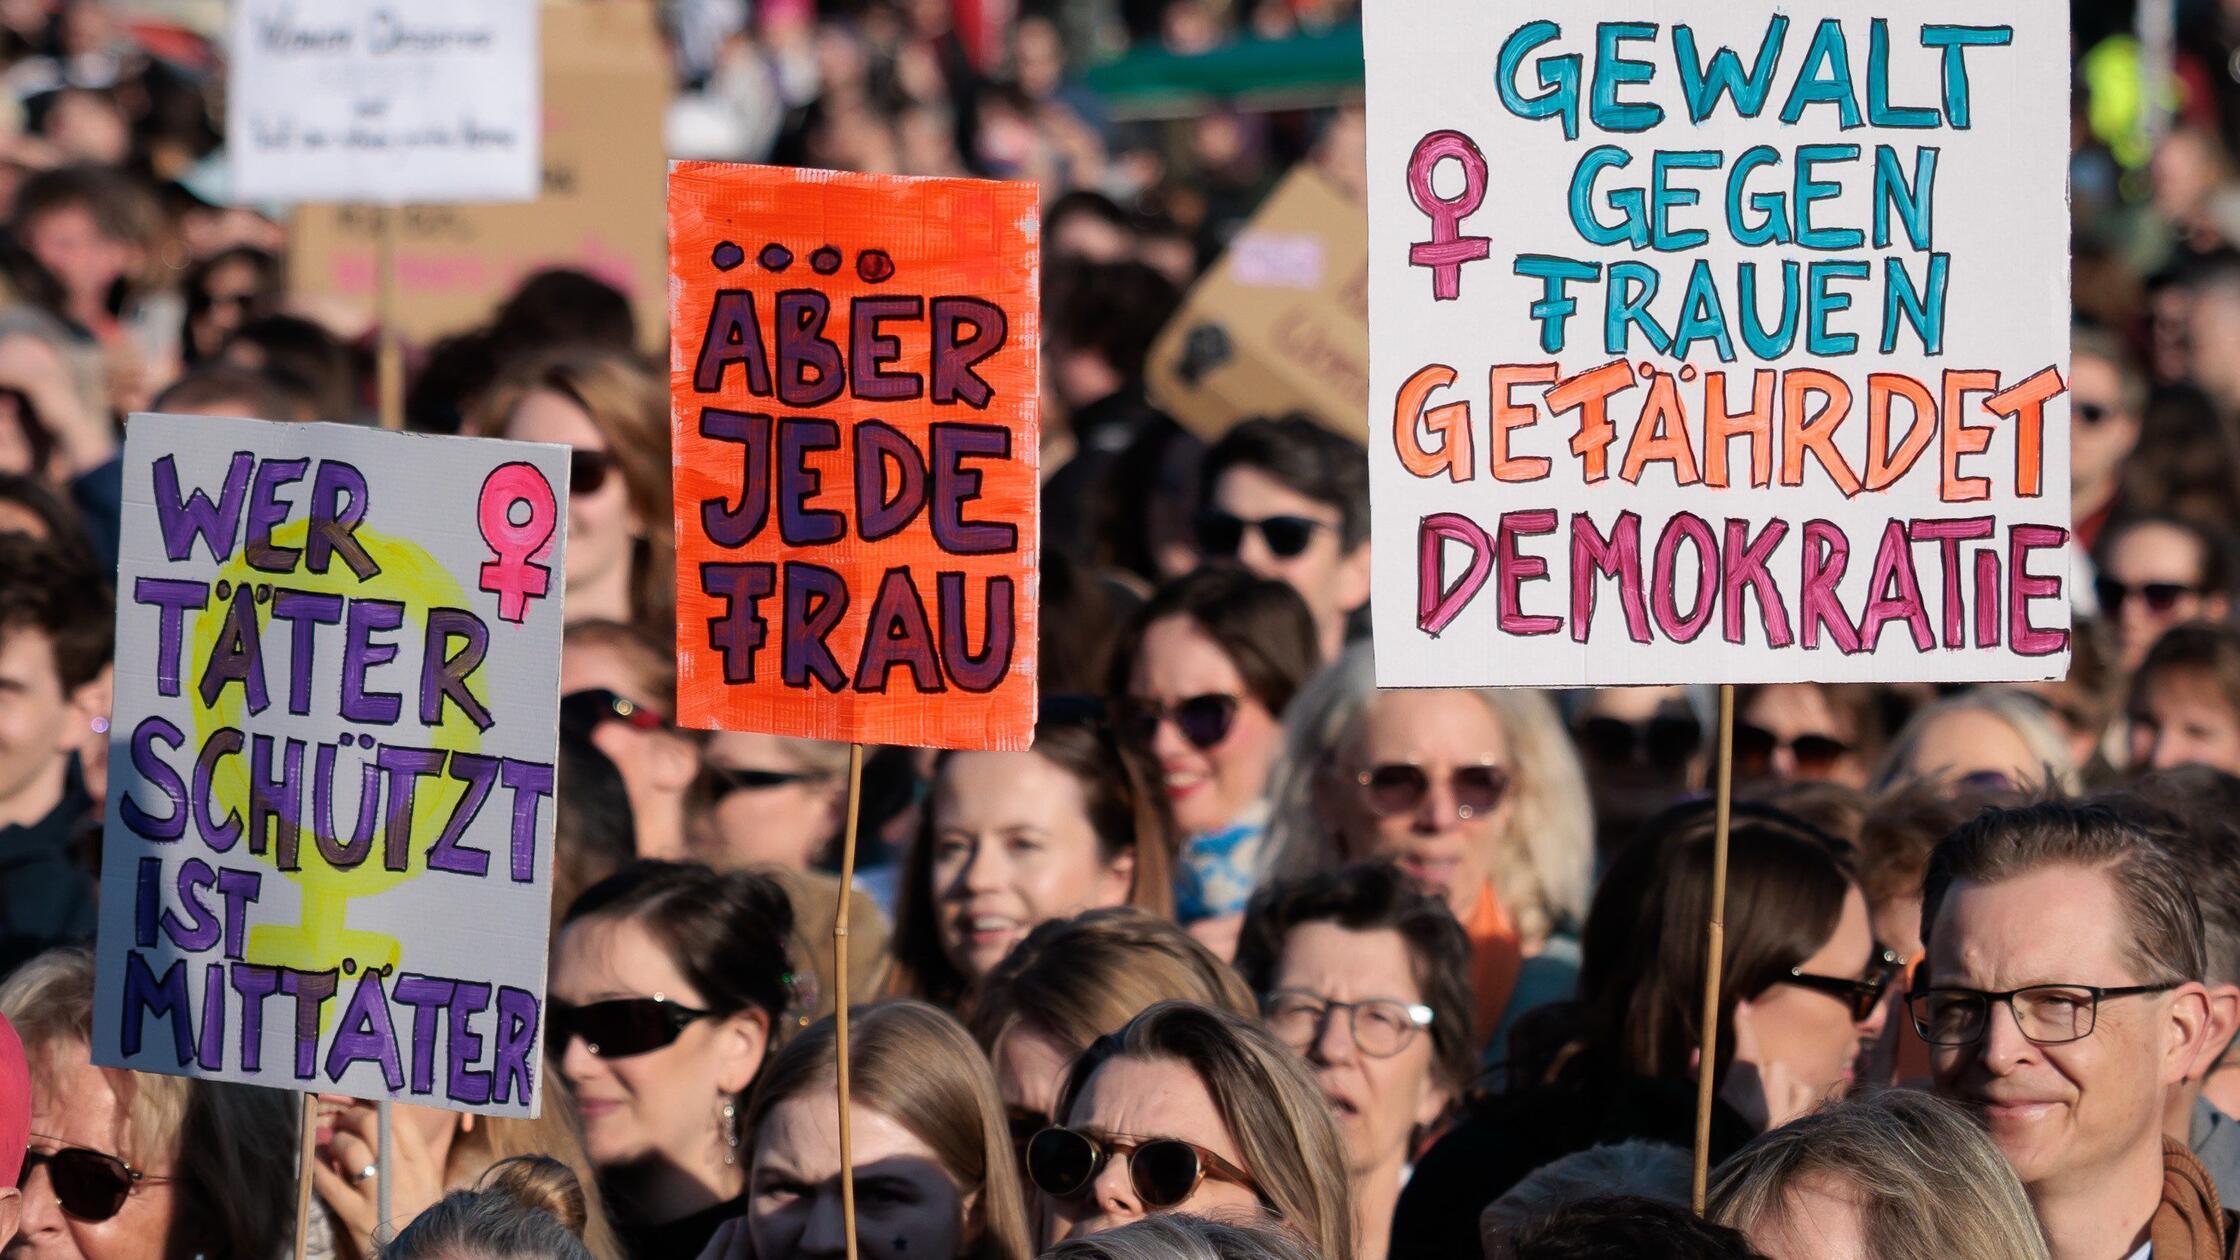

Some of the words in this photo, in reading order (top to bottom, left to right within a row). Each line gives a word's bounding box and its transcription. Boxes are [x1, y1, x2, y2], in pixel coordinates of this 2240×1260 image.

[1497, 10, 2014, 141] GEWALT
[1568, 144, 1941, 253] GEGEN
[1513, 253, 1951, 362] FRAUEN
[699, 407, 1018, 556] JEDE
[1393, 359, 2067, 502] GEFÄHRDET
[152, 450, 382, 582] WER
[1417, 508, 2070, 656] DEMOKRATIE
[134, 574, 495, 734] TÄTER
[699, 560, 1016, 694] FRAU
[120, 715, 555, 884] SCHÜTZT
[135, 856, 262, 960] IST
[121, 949, 542, 1106] MITTÄTER
